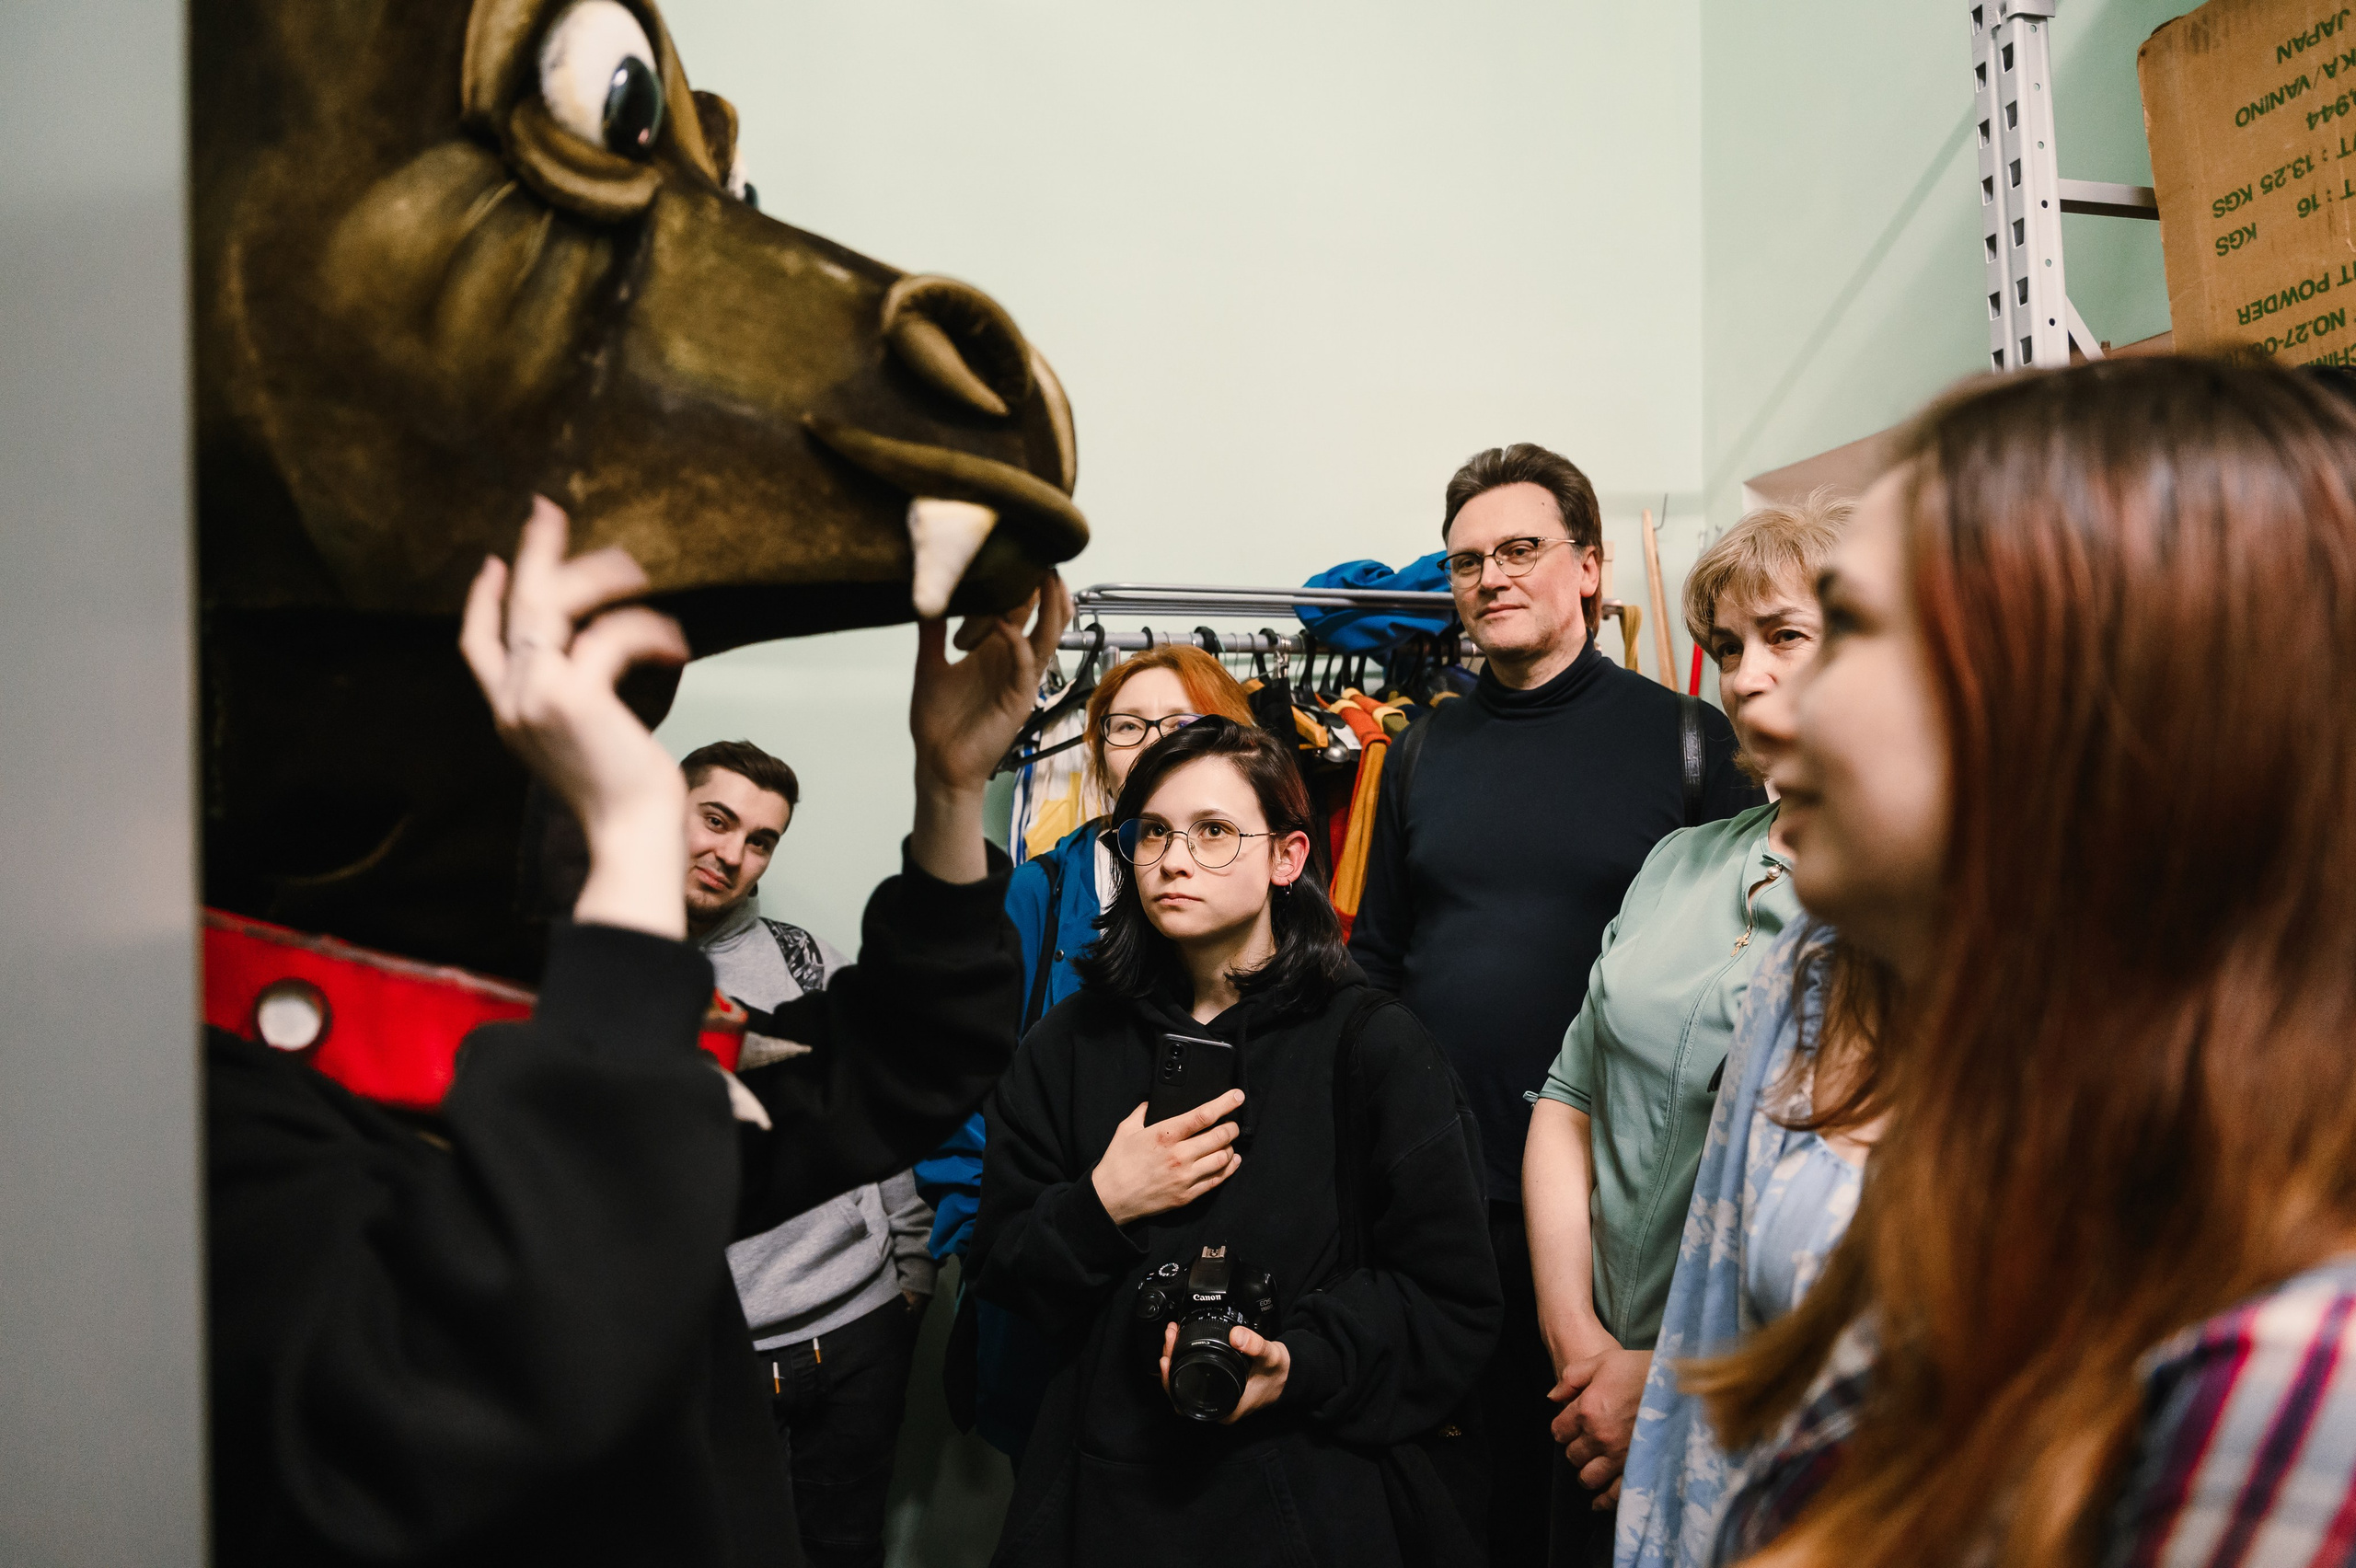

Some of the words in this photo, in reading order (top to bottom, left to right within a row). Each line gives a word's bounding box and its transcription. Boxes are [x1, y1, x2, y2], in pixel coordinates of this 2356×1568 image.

[2277, 9, 2350, 64] JAPAN
[2305, 88, 2356, 131] ,944
[2336, 133, 2356, 159] T
[2259, 155, 2316, 196] 13.25
[2212, 184, 2254, 219] KGS
[2296, 193, 2321, 219] 16
[2215, 222, 2258, 257] KGS
[2336, 260, 2356, 287] T
[2236, 271, 2331, 326] POWDER
[1193, 1294, 1222, 1302] Canon
[1259, 1297, 1272, 1307] EOS
